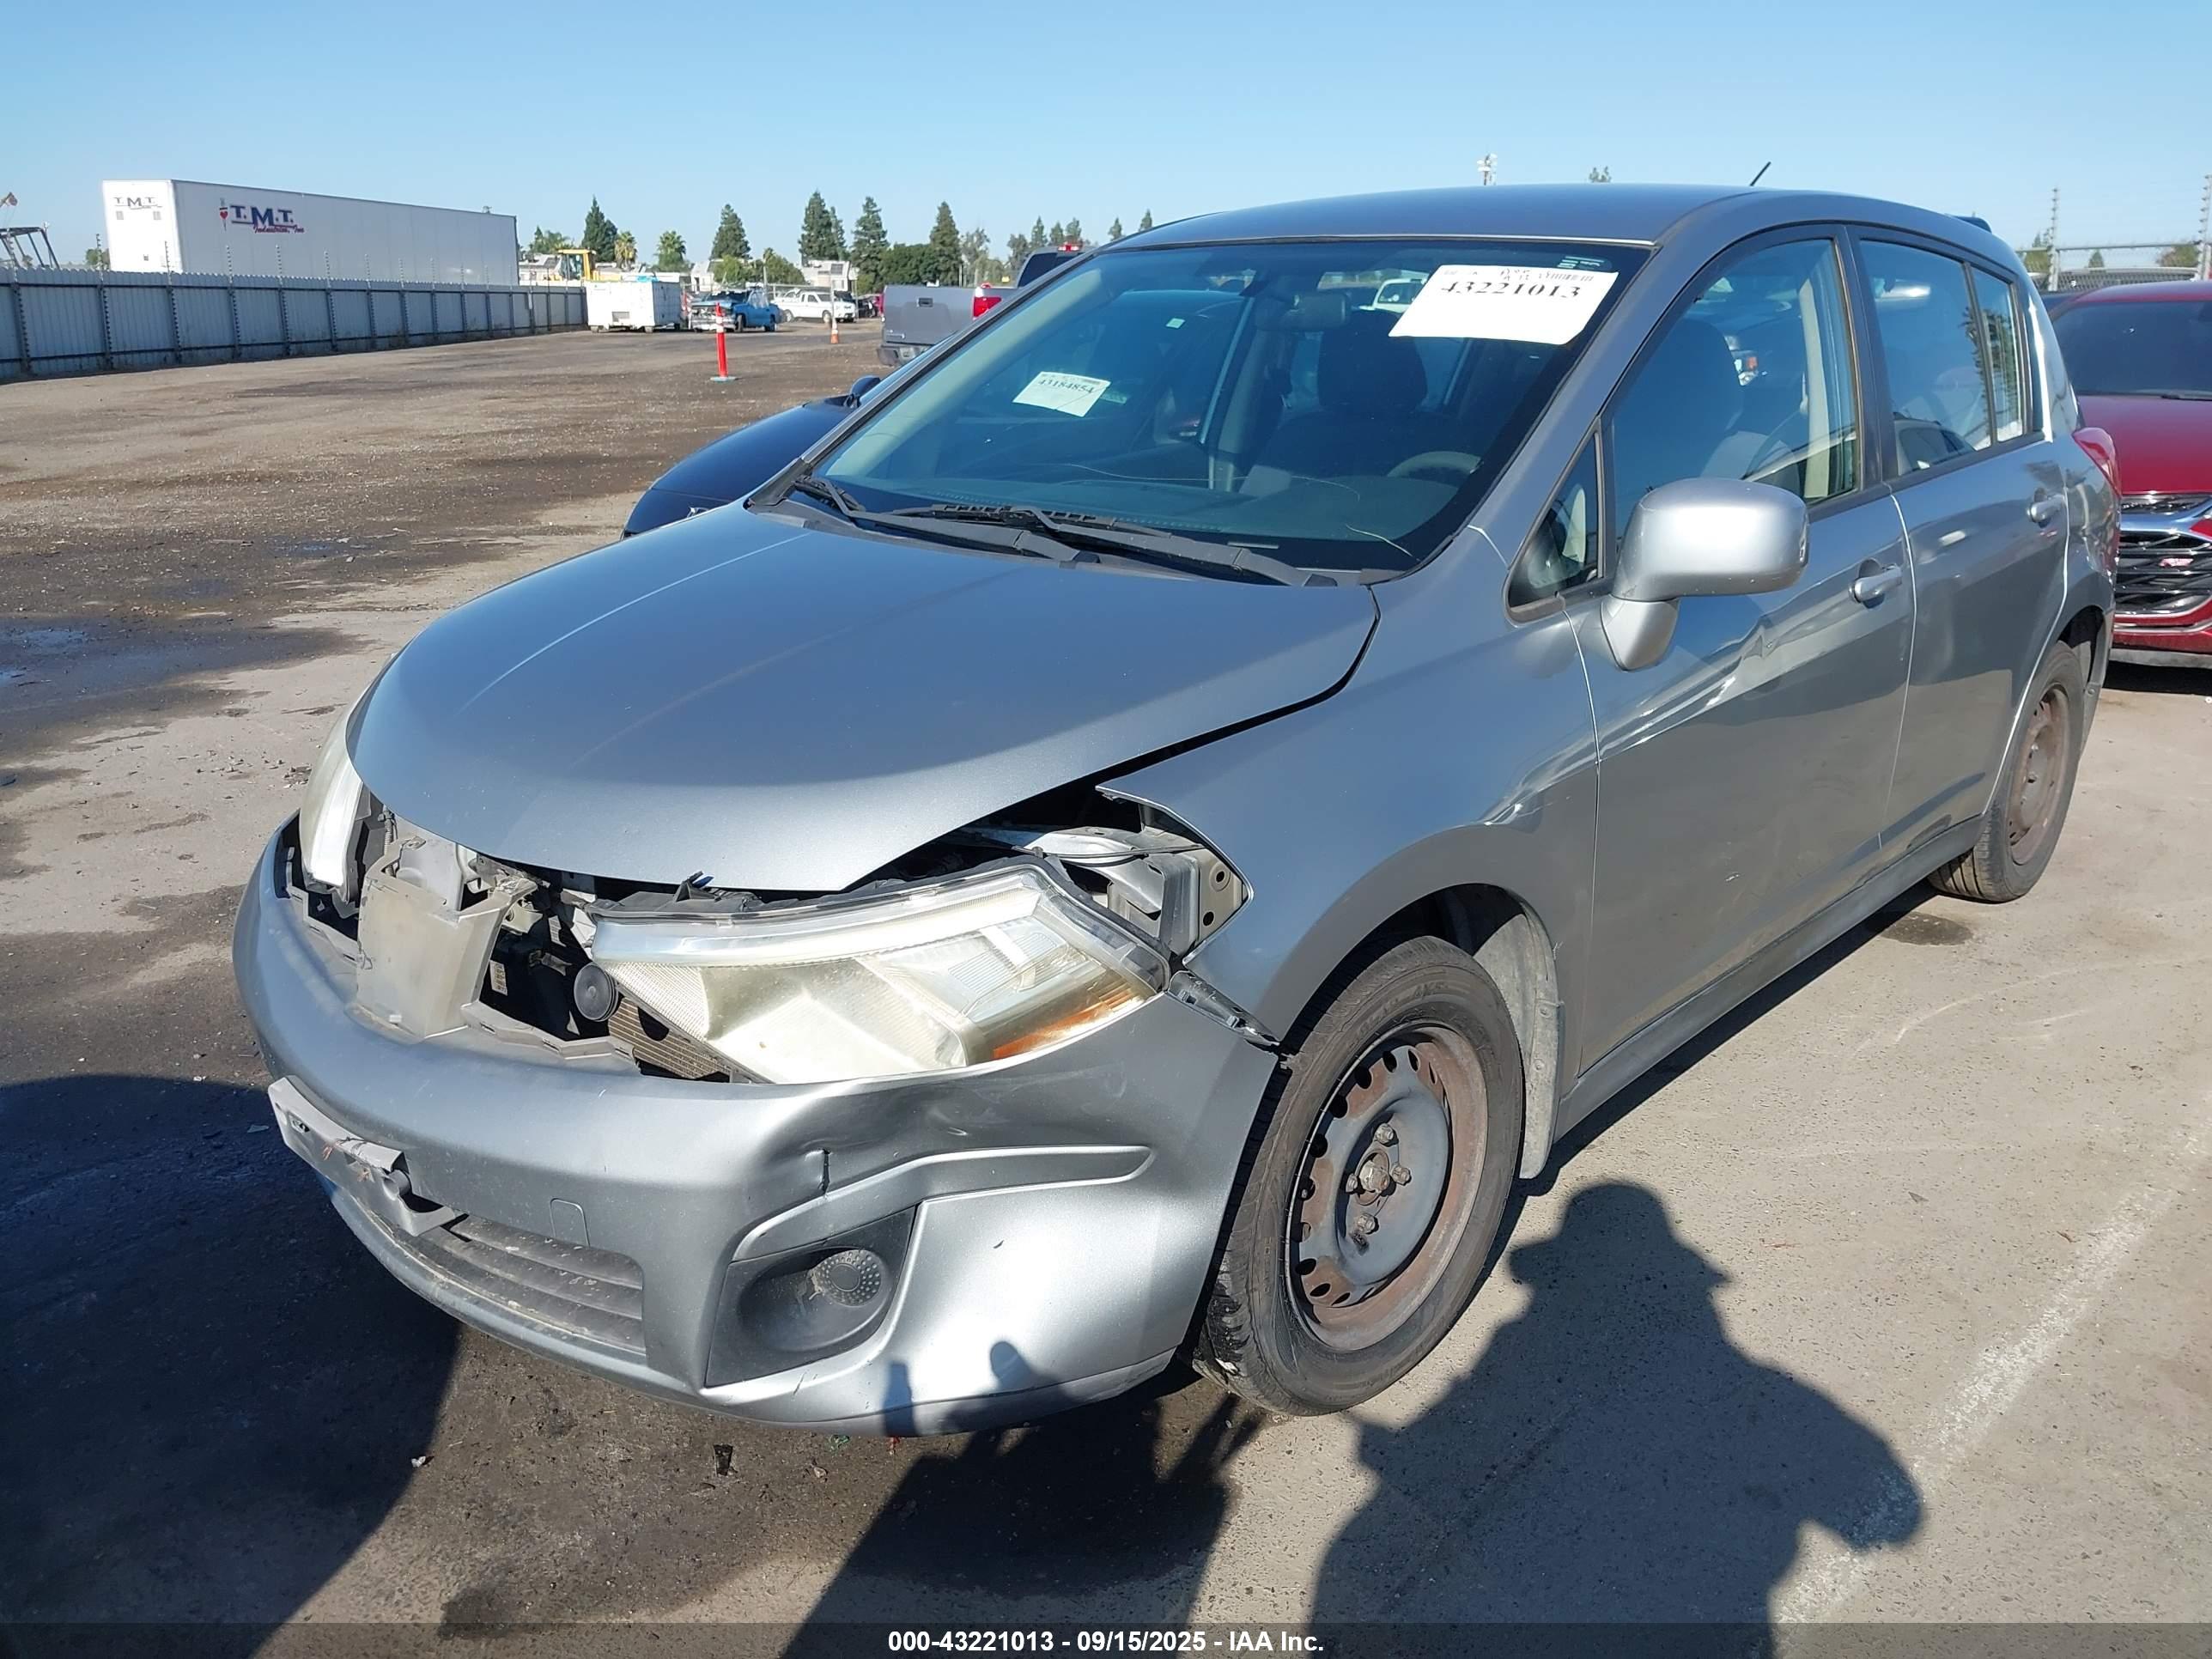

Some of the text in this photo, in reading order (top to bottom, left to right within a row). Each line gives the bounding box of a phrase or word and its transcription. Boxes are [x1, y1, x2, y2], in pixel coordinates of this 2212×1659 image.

[229, 205, 294, 226] T.M.T.
[1441, 280, 1582, 299] 43221013
[1038, 379, 1095, 393] 43184854
